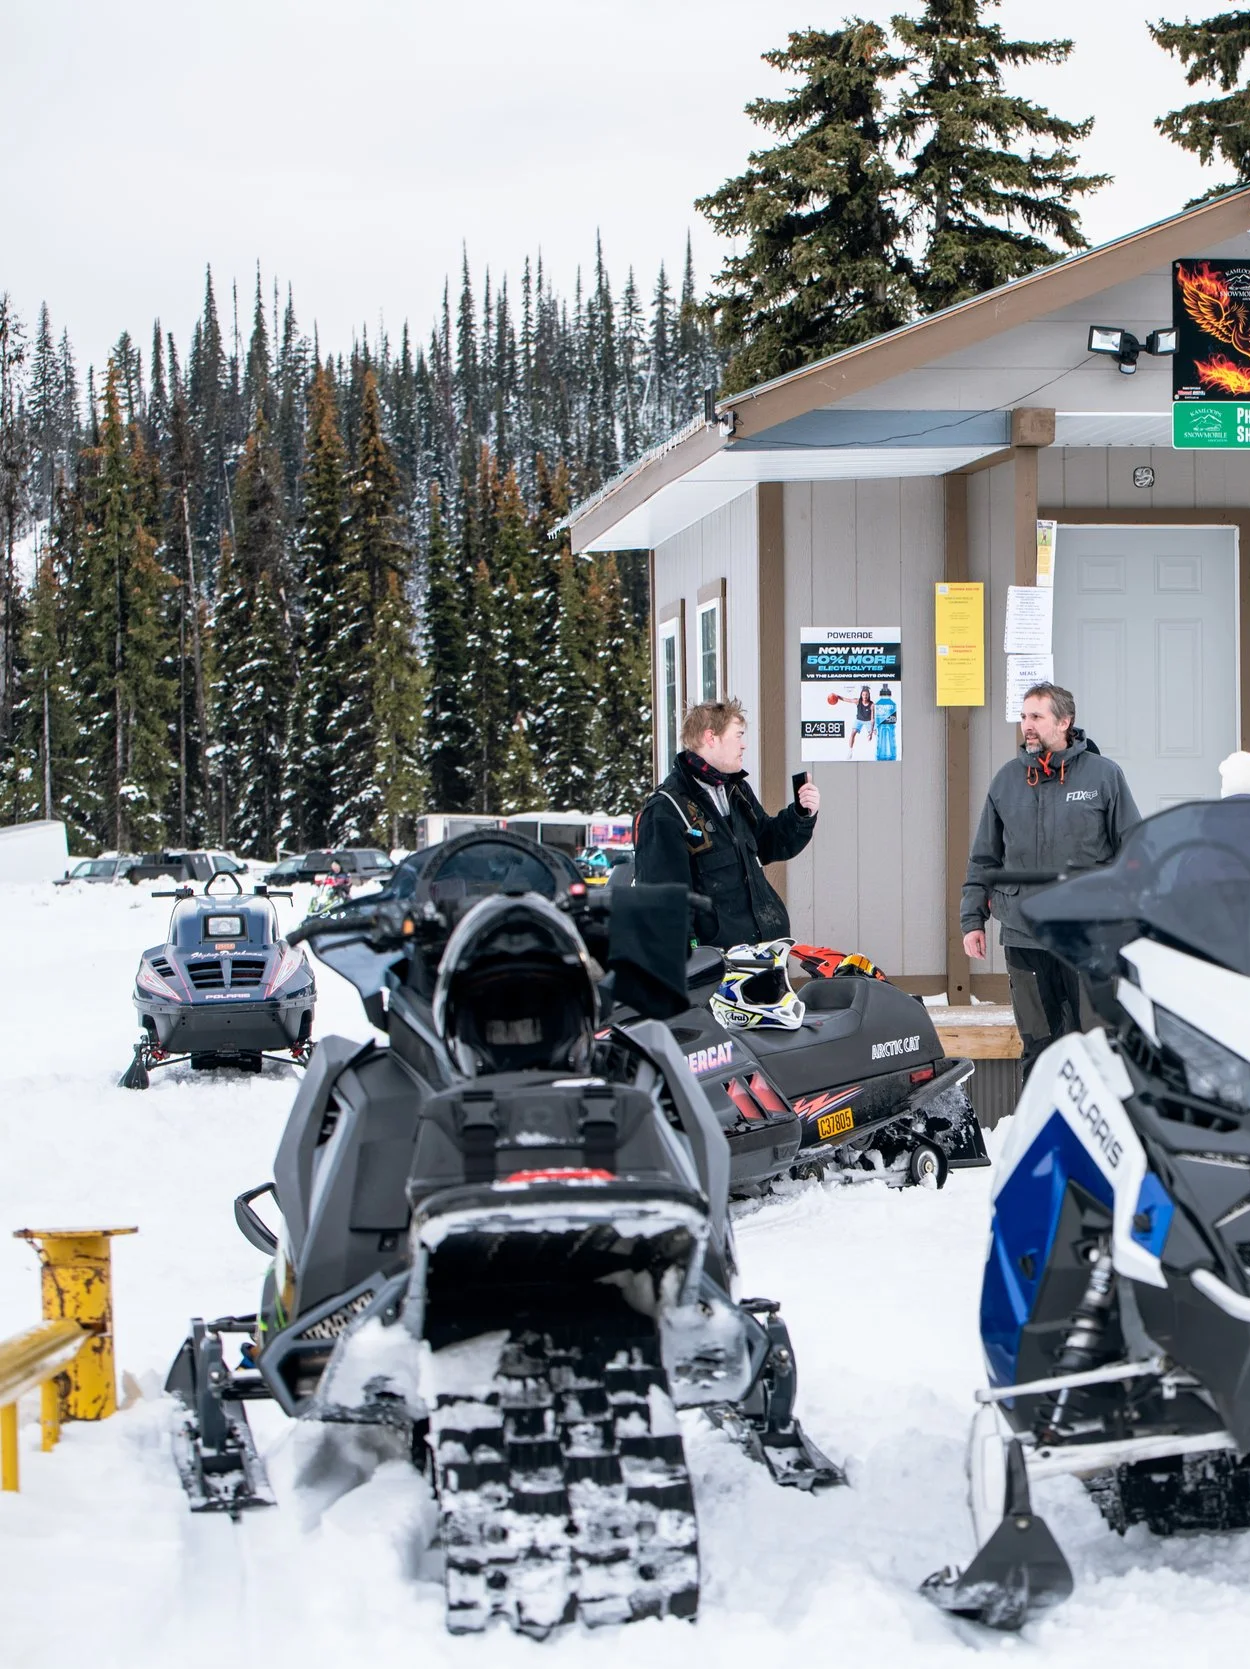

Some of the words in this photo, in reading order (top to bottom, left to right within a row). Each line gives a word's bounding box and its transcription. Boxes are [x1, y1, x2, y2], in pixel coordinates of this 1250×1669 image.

[1189, 407, 1223, 417] KAMLOOPS
[806, 655, 846, 665] 50%
[848, 655, 896, 664] MORE
[1066, 790, 1087, 802] FOX
[730, 1012, 746, 1022] Arai
[871, 1039, 902, 1060] ARCTIC
[902, 1035, 920, 1053] CAT
[1058, 1059, 1123, 1169] POLARIS
[820, 1113, 852, 1137] C37805
